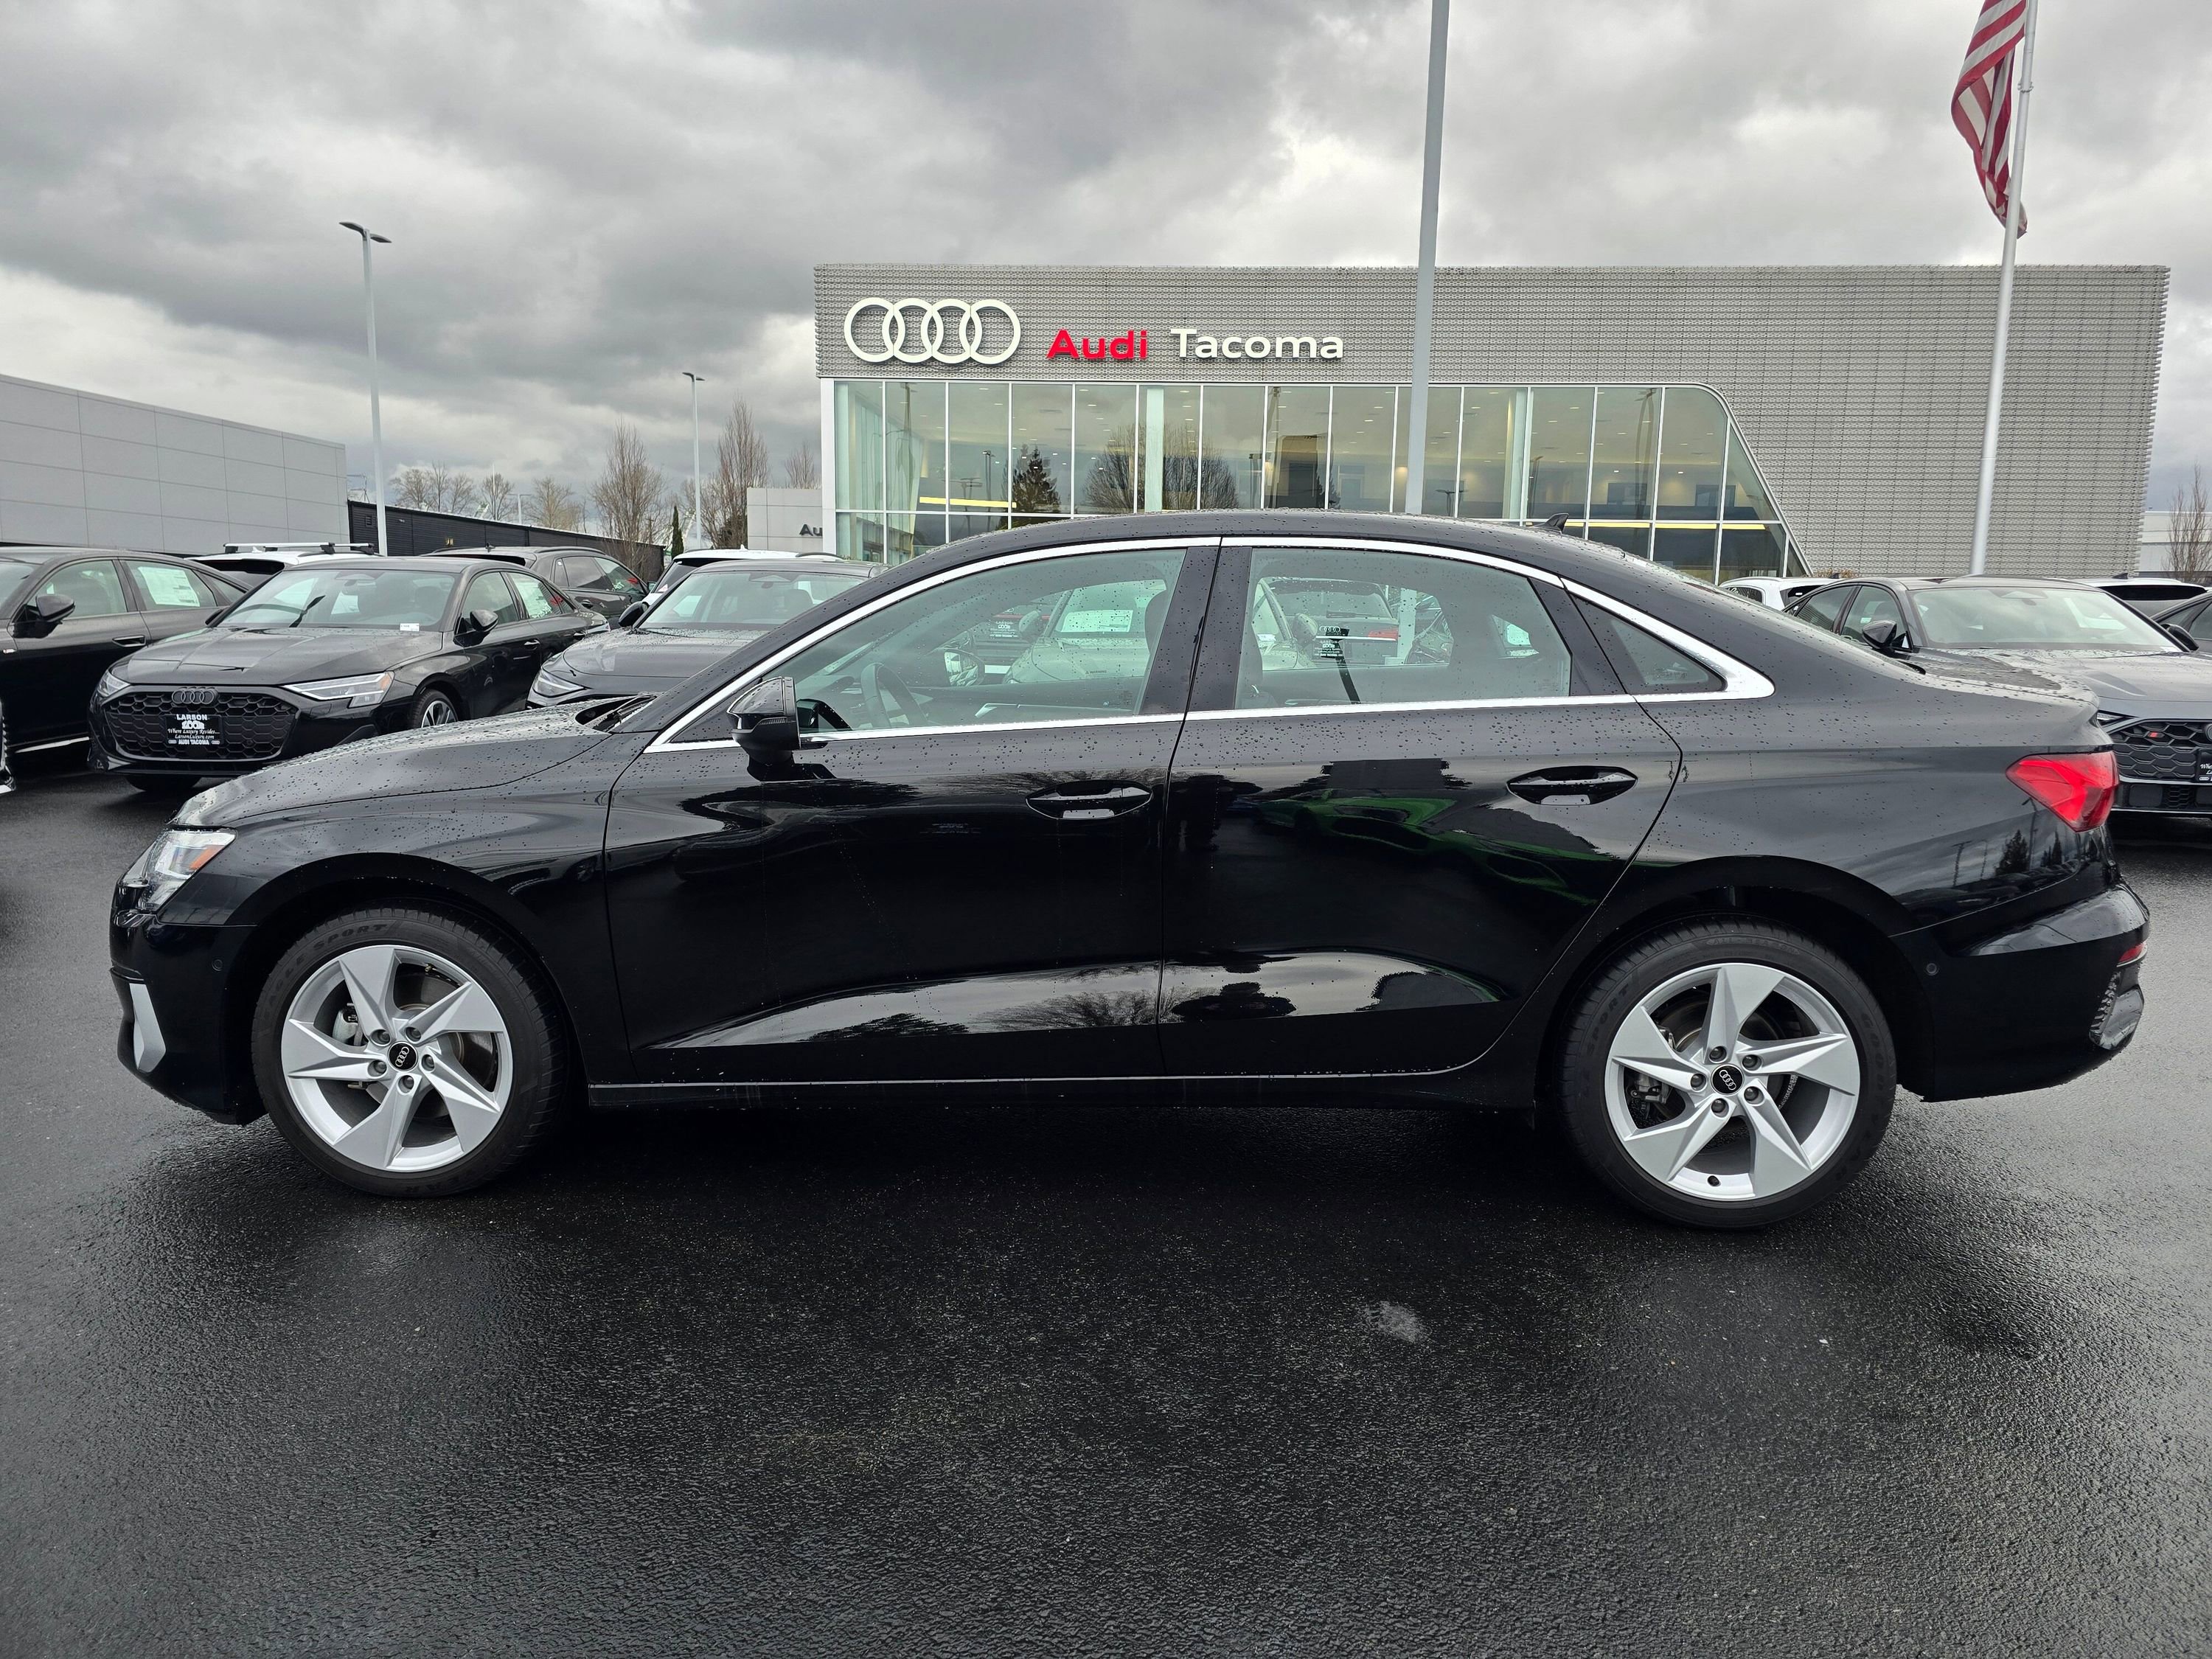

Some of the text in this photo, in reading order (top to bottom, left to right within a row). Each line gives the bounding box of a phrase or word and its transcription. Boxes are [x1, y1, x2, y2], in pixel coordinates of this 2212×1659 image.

[1046, 328, 1343, 359] Audi Tacoma
[313, 924, 387, 950] SPORT
[1586, 983, 1630, 1055] SPORT
